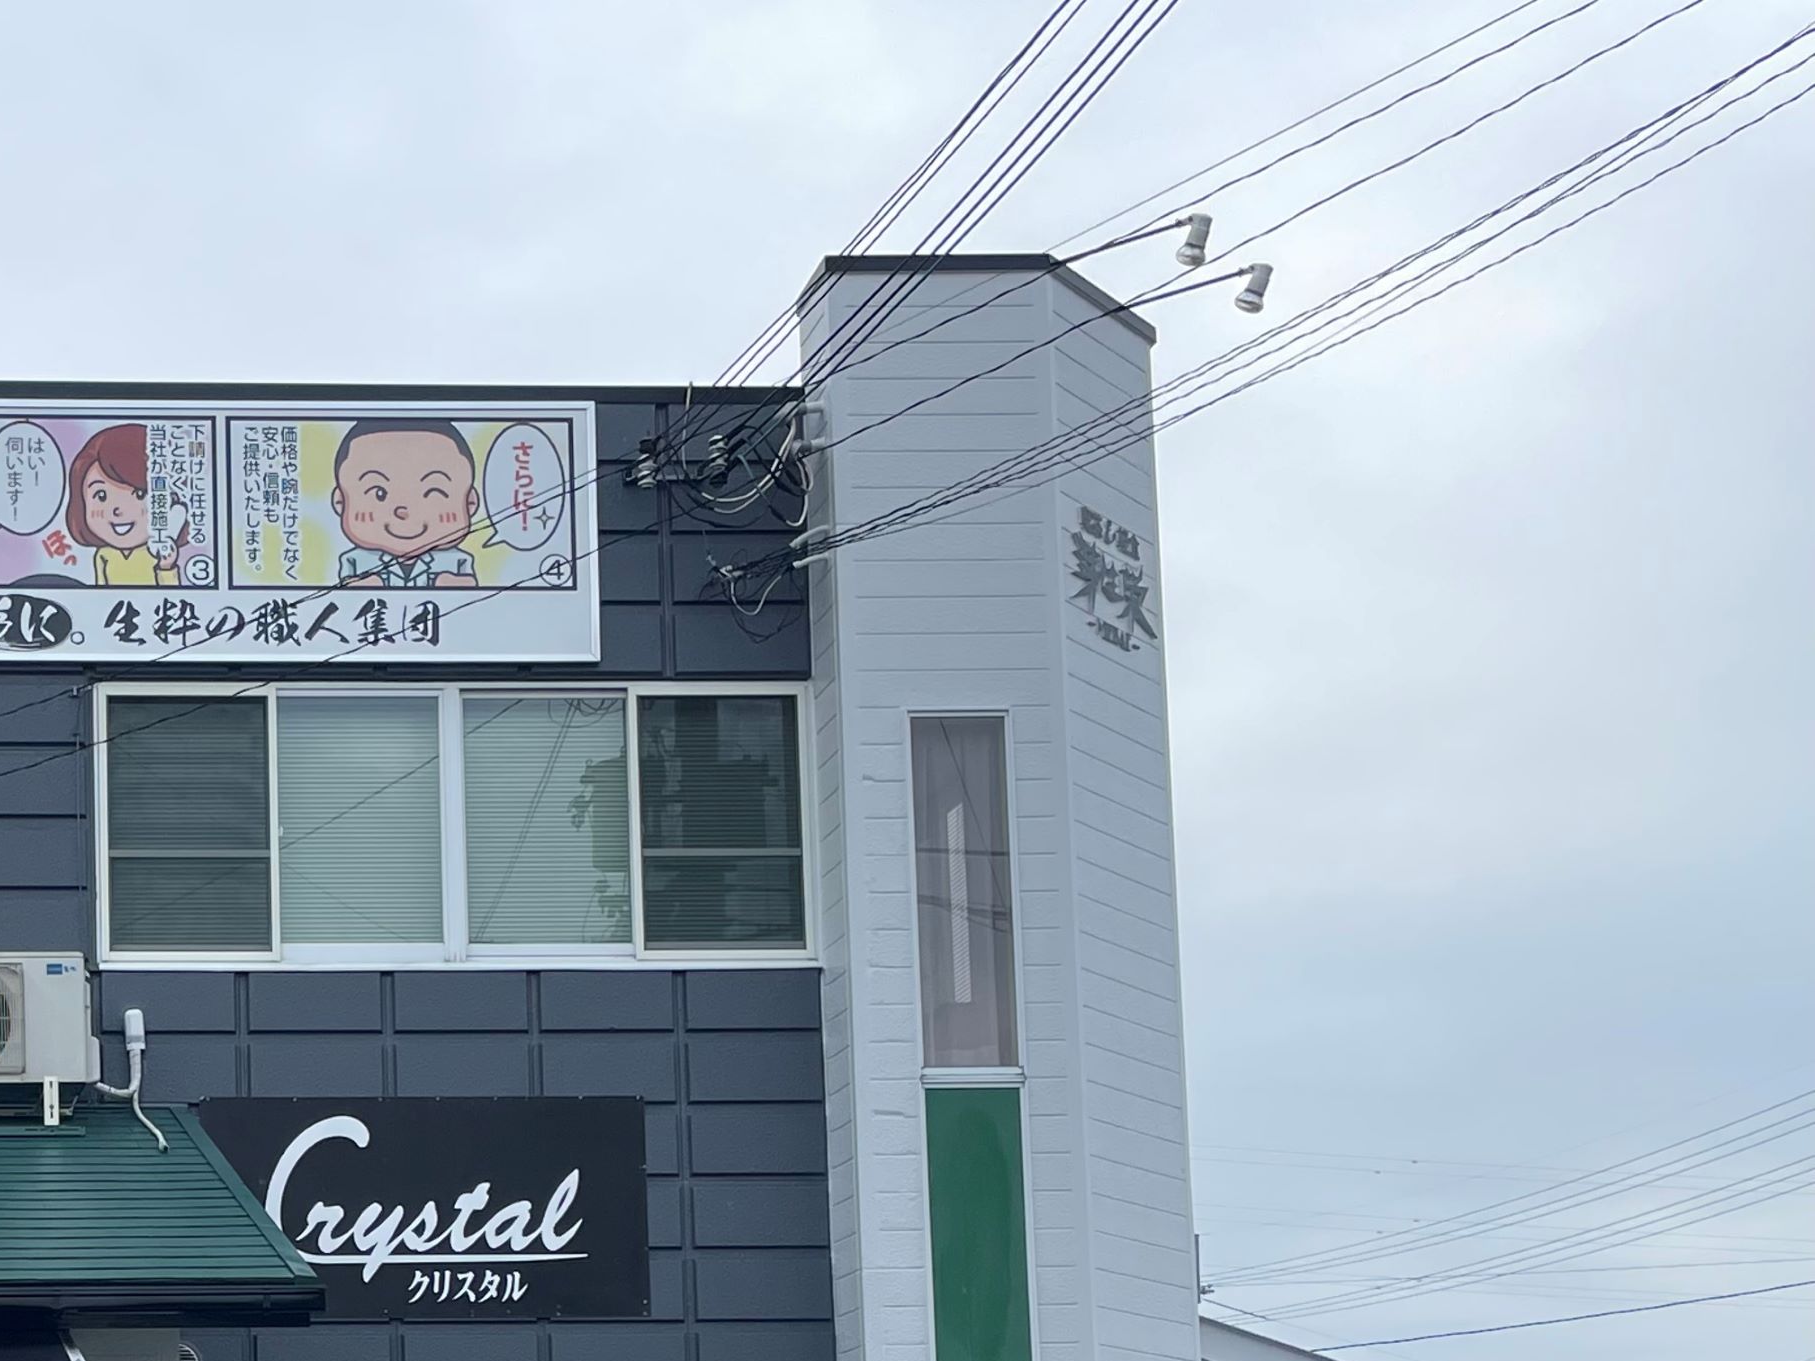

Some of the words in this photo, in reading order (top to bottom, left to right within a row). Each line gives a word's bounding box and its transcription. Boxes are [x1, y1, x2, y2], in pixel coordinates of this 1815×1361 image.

[243, 426, 262, 573] ご提供いたします。
[261, 426, 280, 524] 安心・信頼も
[281, 426, 299, 580] 価格や腕だけでなく
[265, 1115, 588, 1283] Crystal
[408, 1269, 528, 1303] クリスタル
